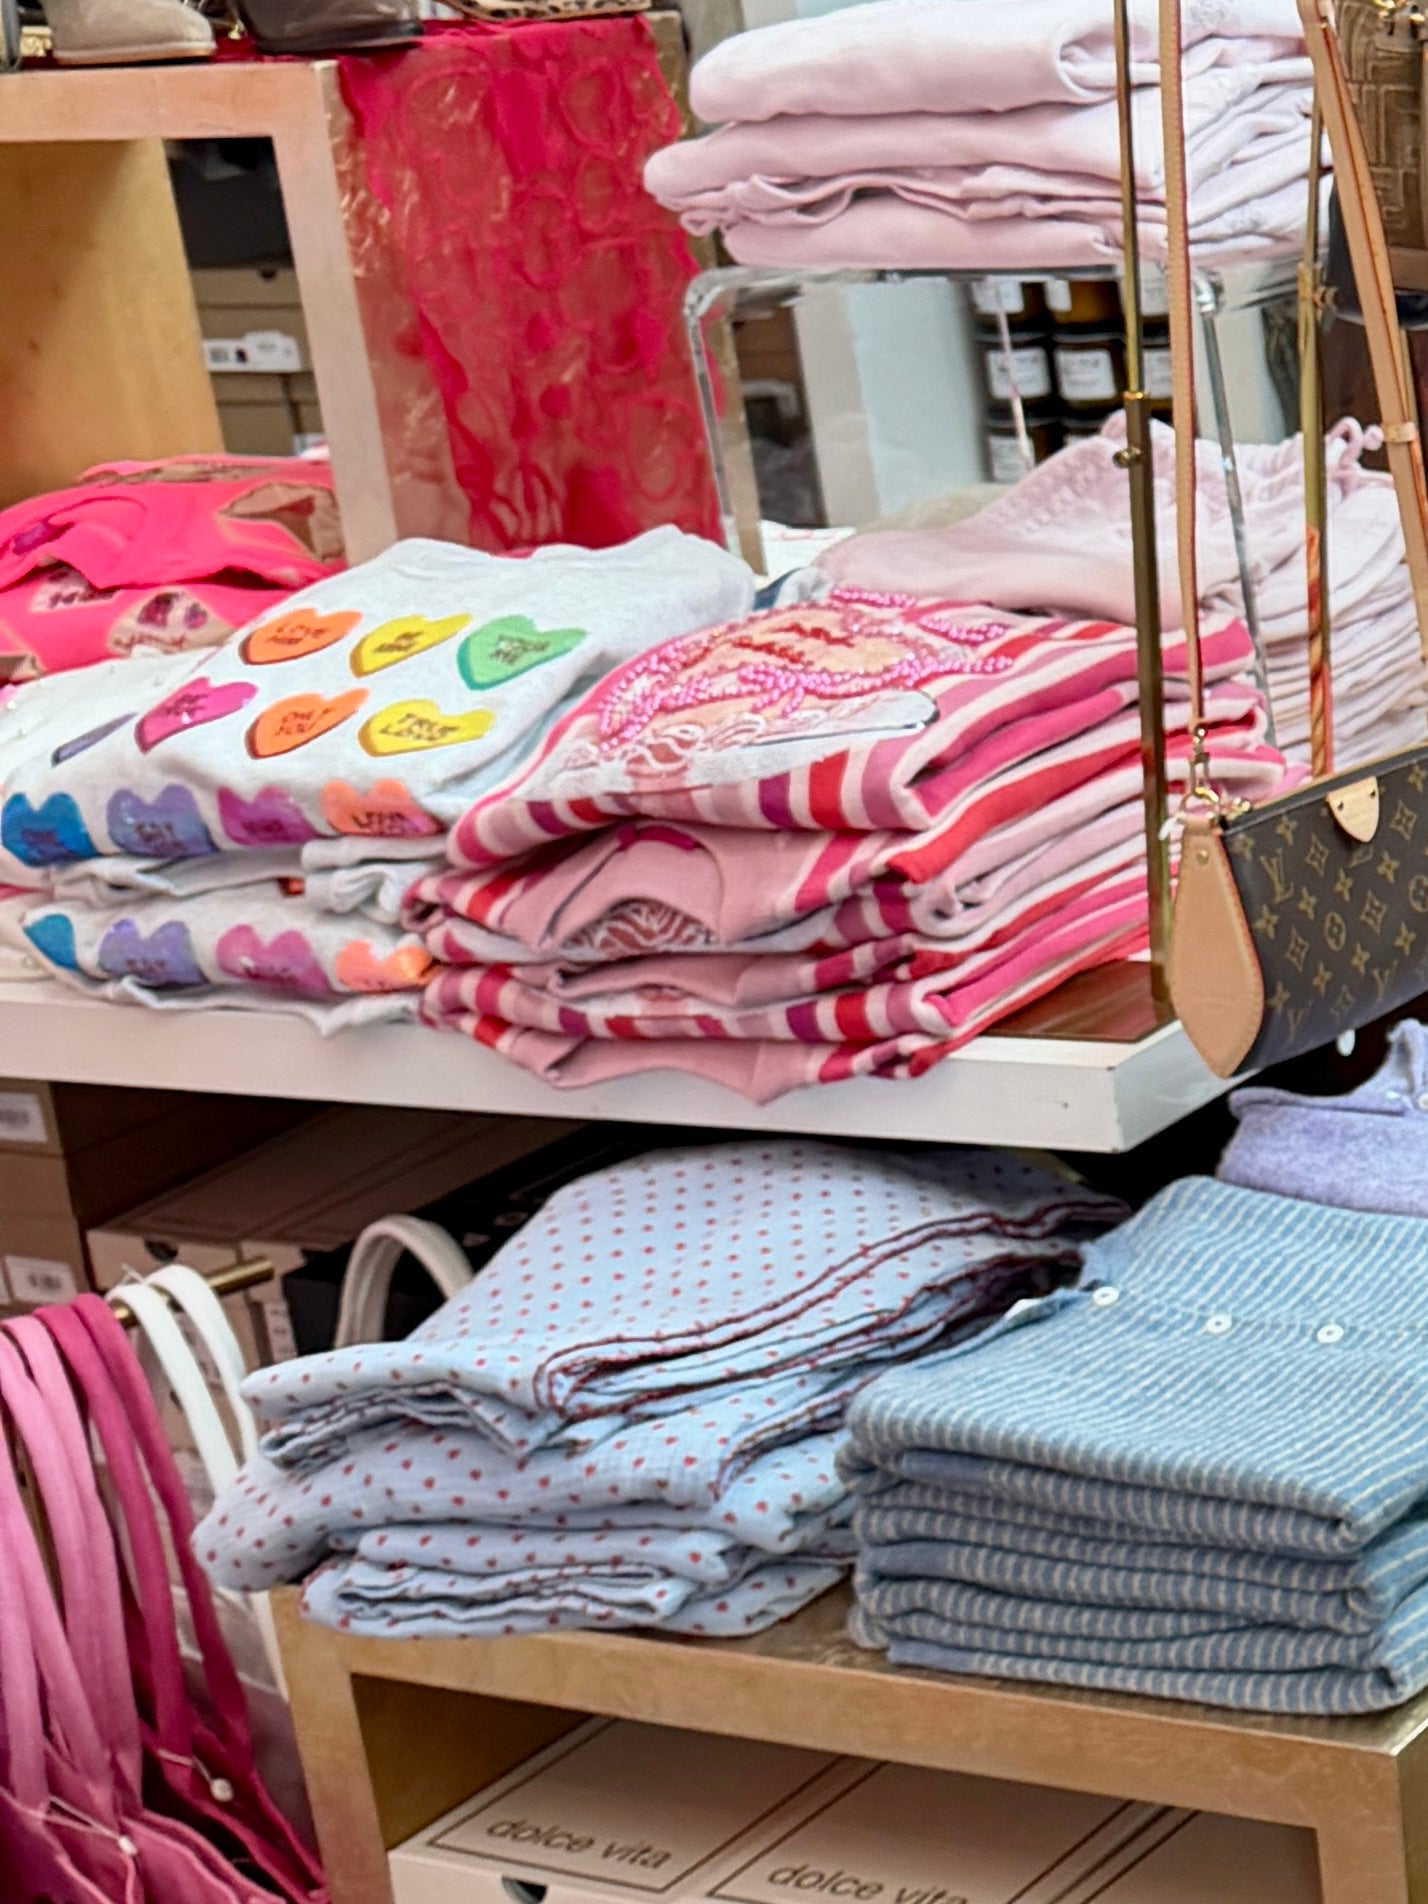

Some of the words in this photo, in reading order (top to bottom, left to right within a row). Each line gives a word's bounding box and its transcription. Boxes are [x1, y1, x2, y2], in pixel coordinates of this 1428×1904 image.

[487, 1818, 595, 1854] dolce
[601, 1841, 671, 1870] vita
[767, 1863, 883, 1899] dolce
